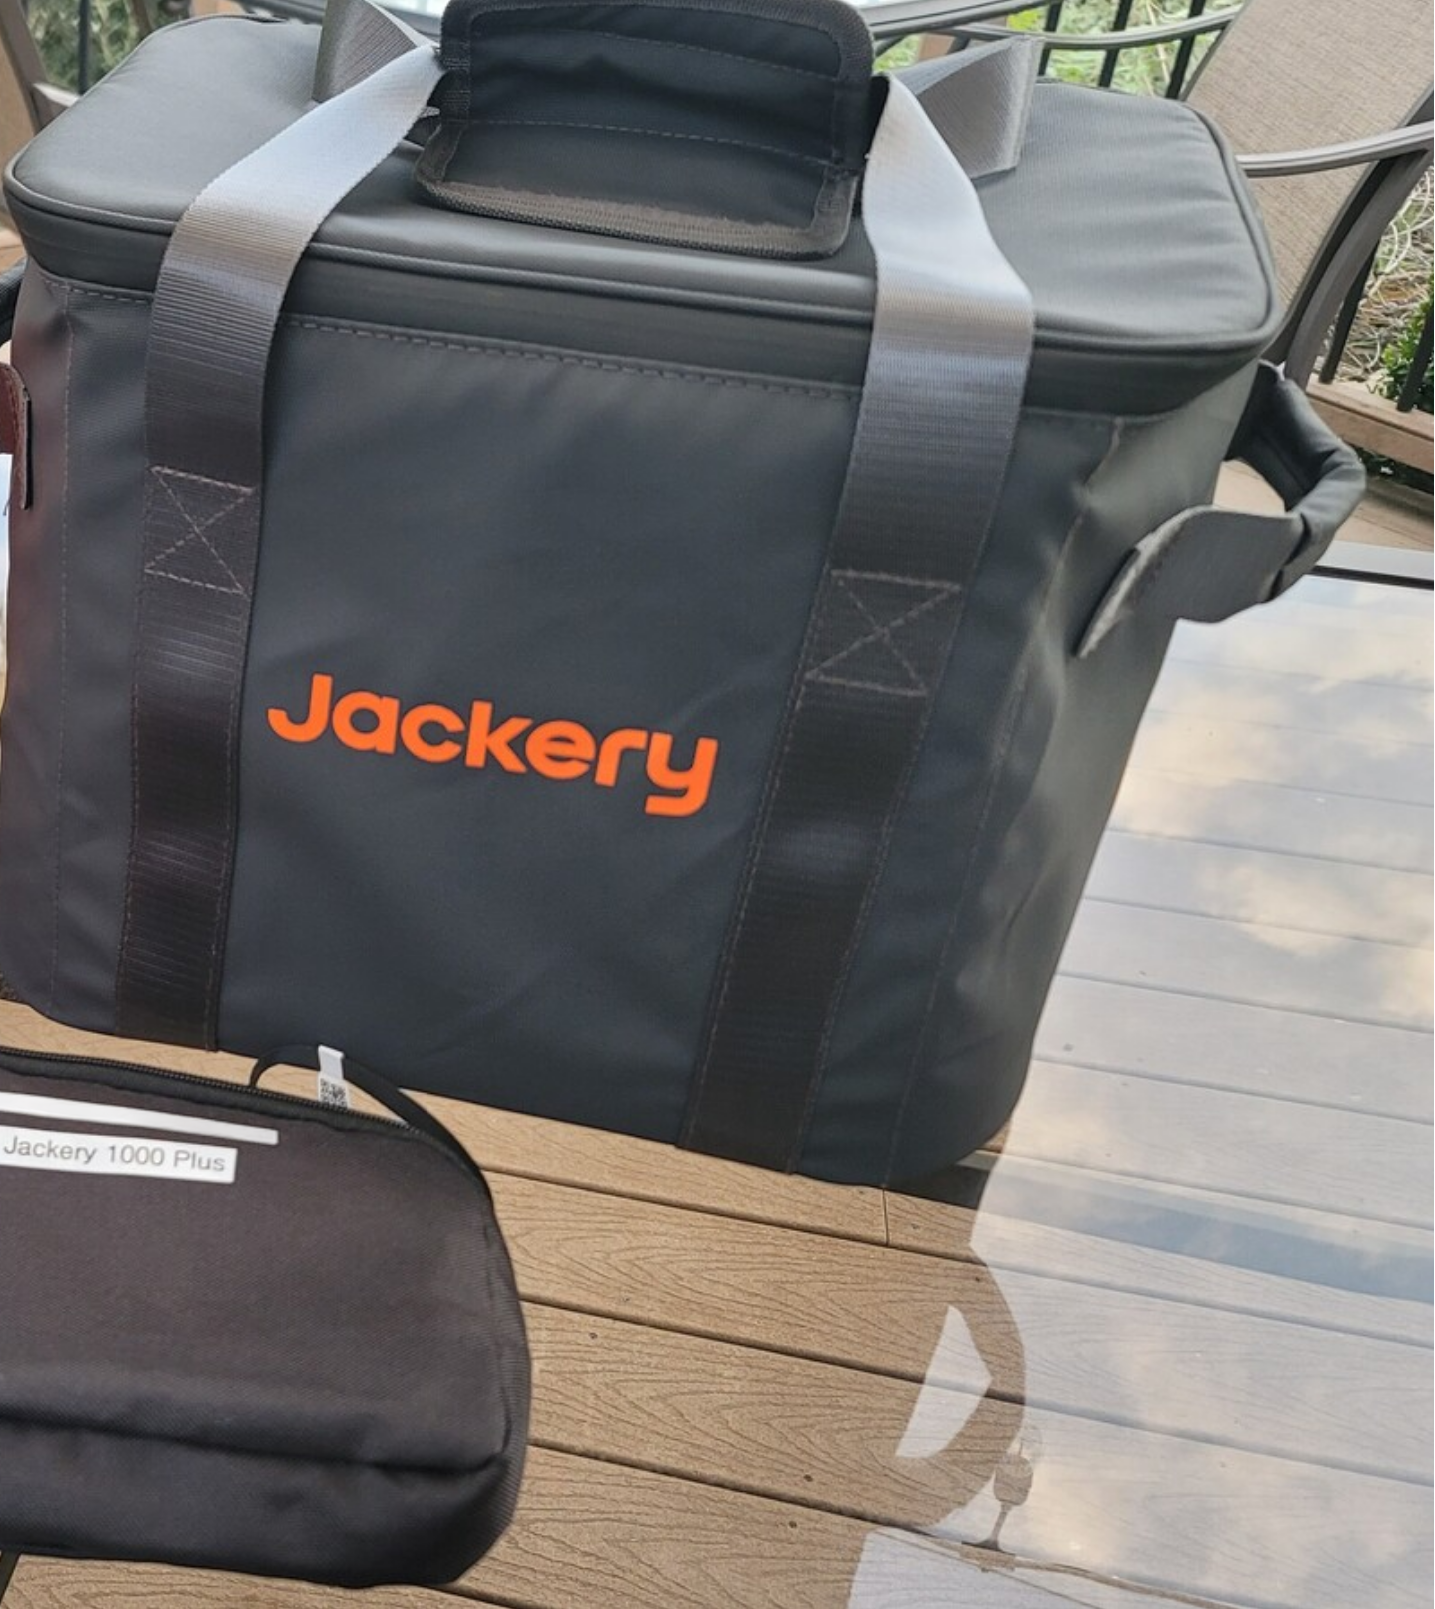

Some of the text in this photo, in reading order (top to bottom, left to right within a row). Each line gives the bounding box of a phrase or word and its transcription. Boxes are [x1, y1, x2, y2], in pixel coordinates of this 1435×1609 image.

[266, 673, 719, 817] Jackery
[3, 1136, 225, 1172] Jackery 1000 Plus
